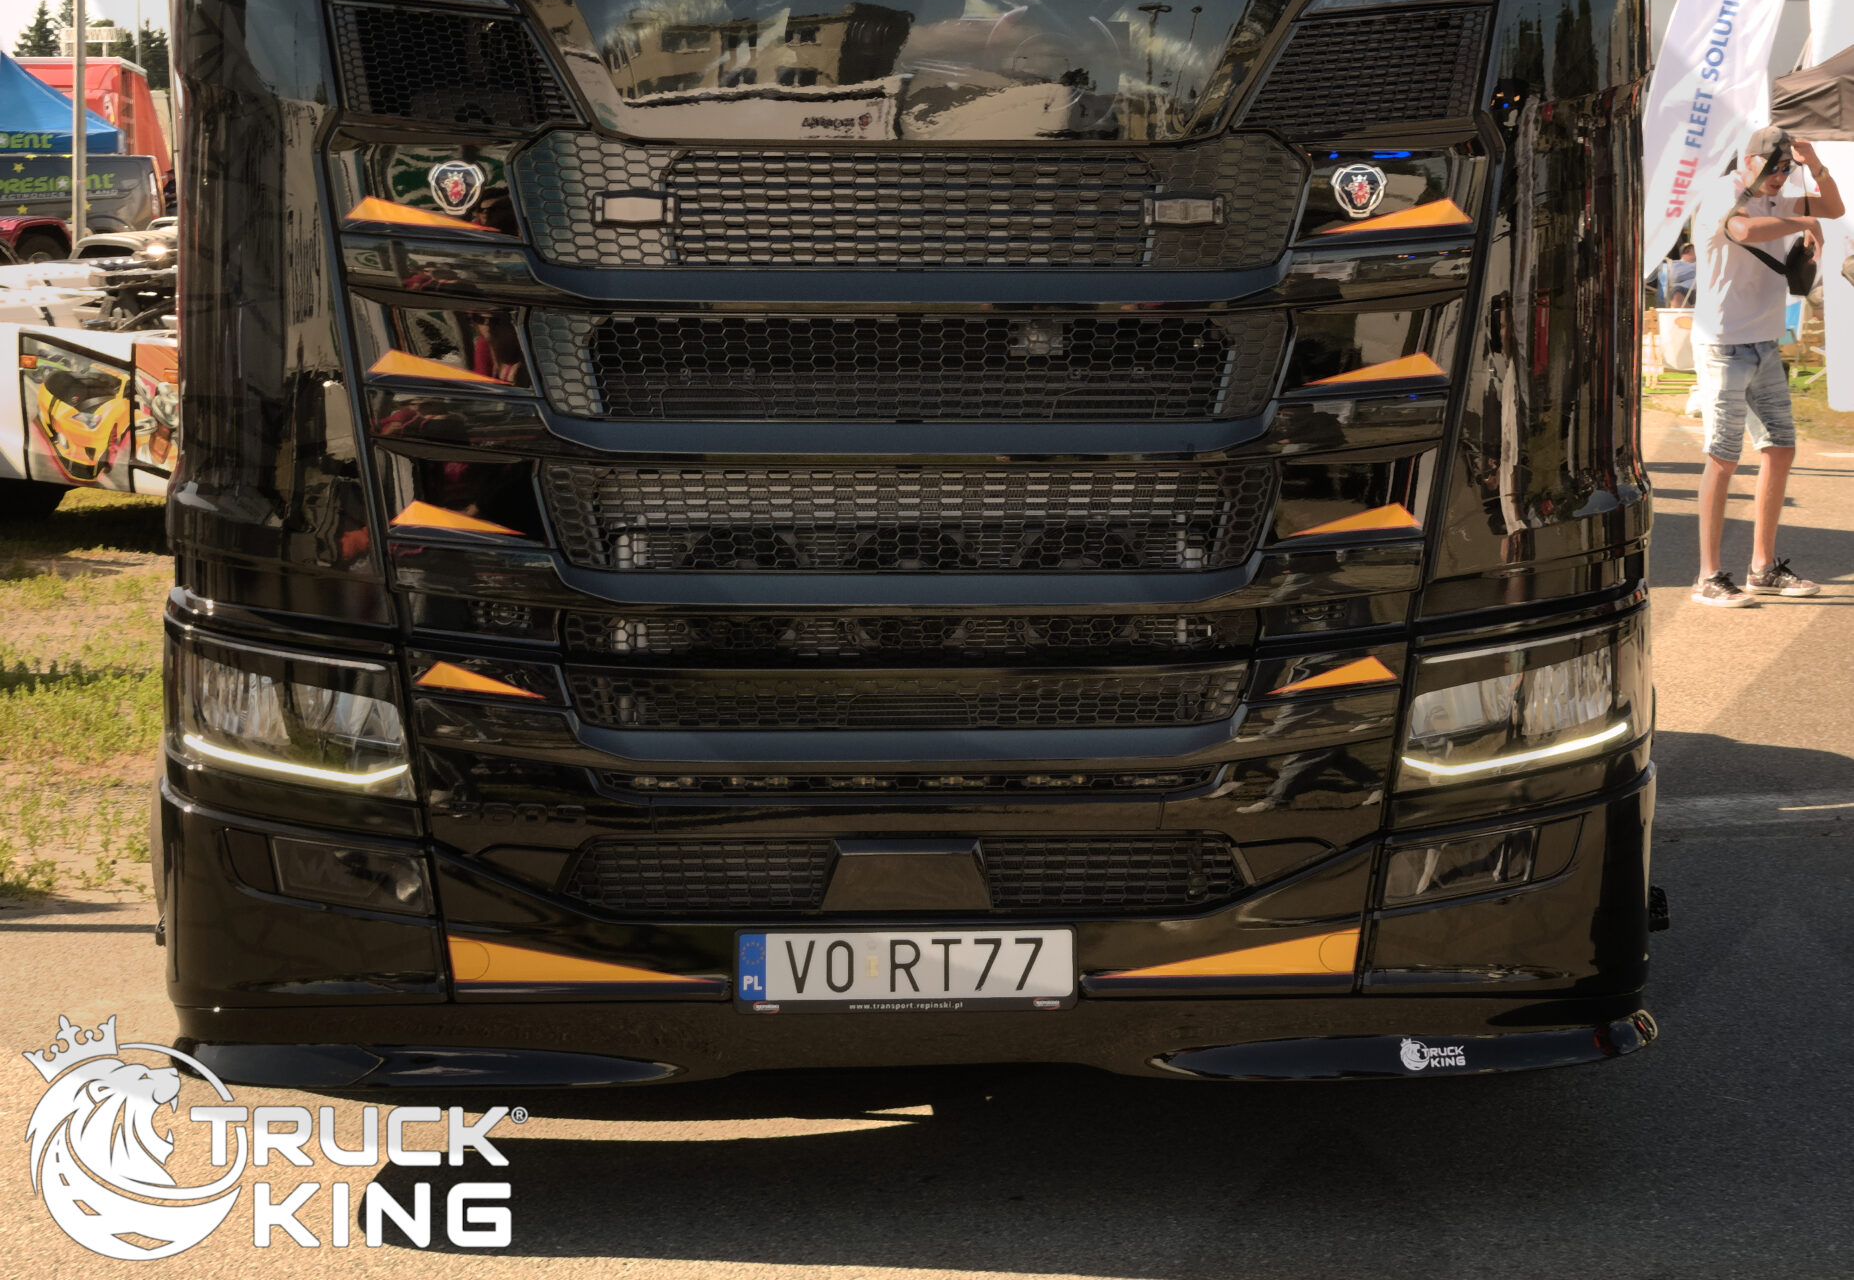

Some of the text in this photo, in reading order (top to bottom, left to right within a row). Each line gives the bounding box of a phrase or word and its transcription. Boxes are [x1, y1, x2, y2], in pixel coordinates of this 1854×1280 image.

[1665, 157, 1699, 218] SHELL
[1684, 88, 1713, 148] FLEET
[785, 937, 1043, 993] VO RT77
[743, 975, 762, 991] PL
[849, 1001, 964, 1011] www.transport.repinski.pl
[1421, 1045, 1465, 1058] TRUCK
[1431, 1055, 1466, 1068] KING
